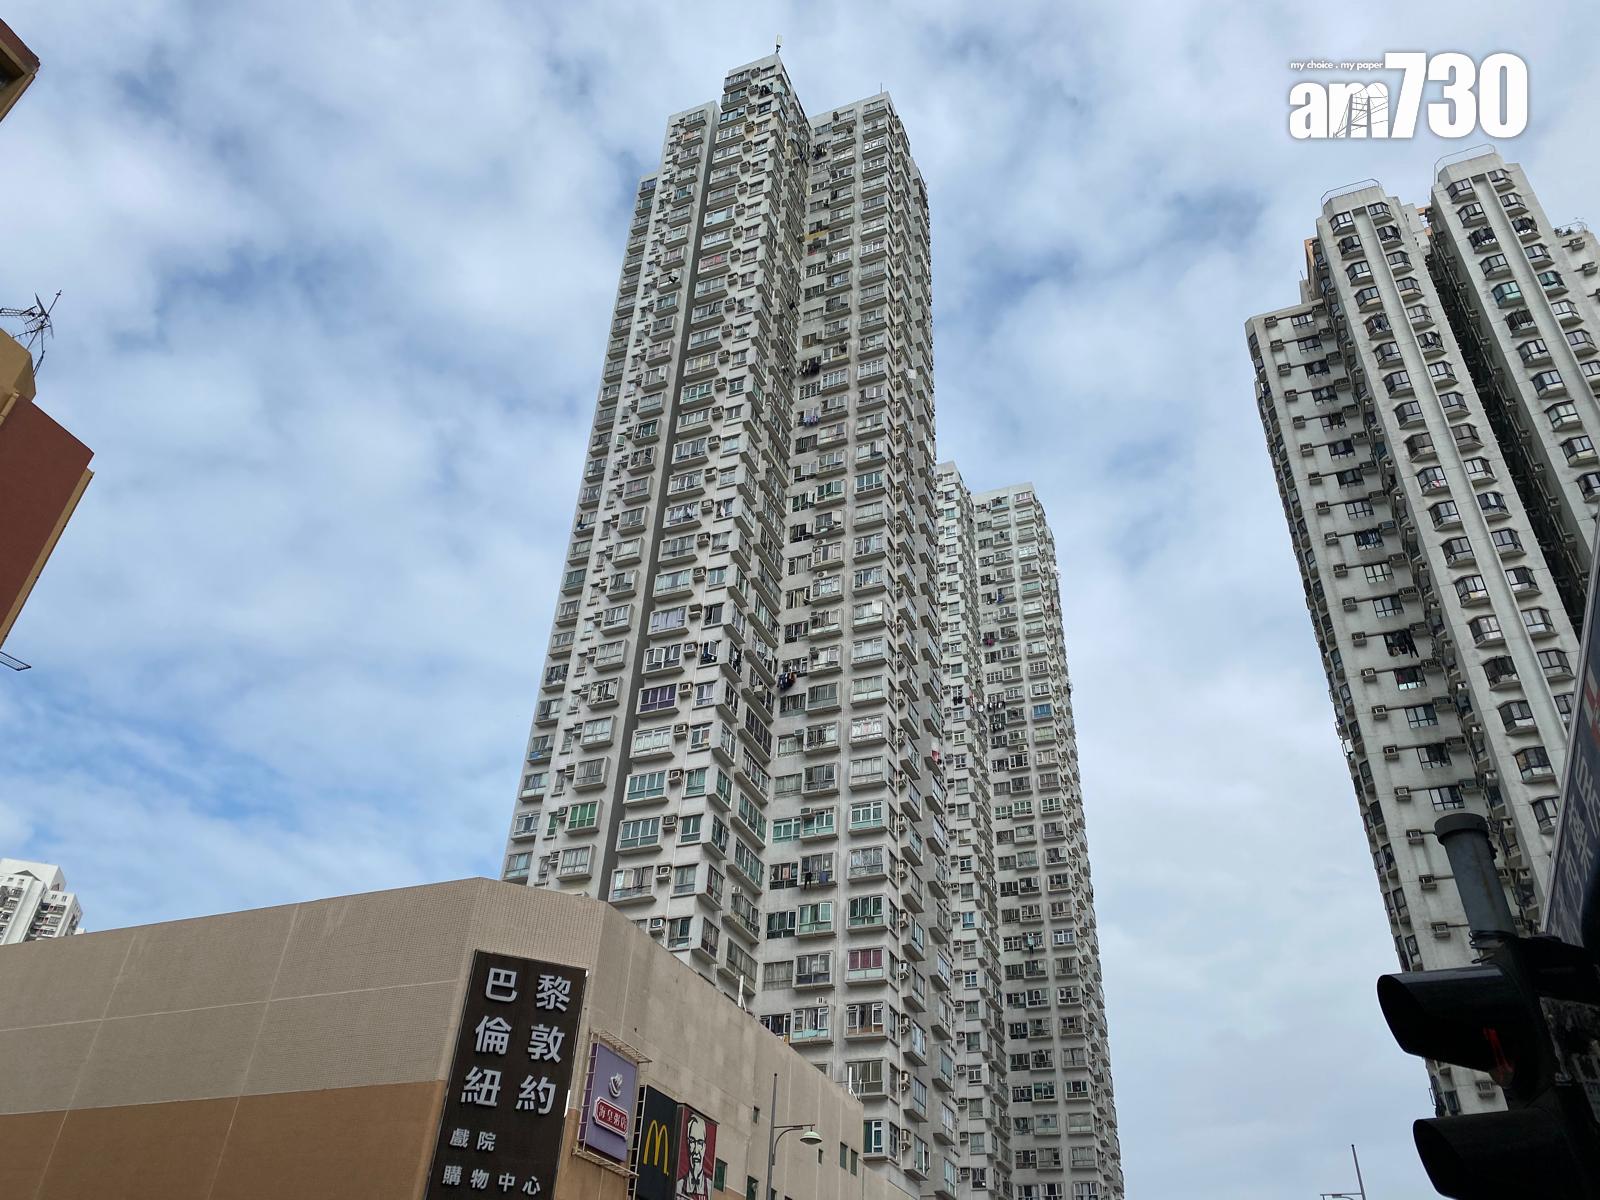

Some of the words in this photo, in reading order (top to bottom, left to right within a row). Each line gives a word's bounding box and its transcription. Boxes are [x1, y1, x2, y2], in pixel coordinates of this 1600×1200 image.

[485, 967, 572, 1012] 巴黎
[475, 1015, 566, 1063] 倫敦
[460, 1066, 557, 1115] 紐約
[449, 1127, 497, 1152] 戲院
[442, 1165, 541, 1196] 購物中心
